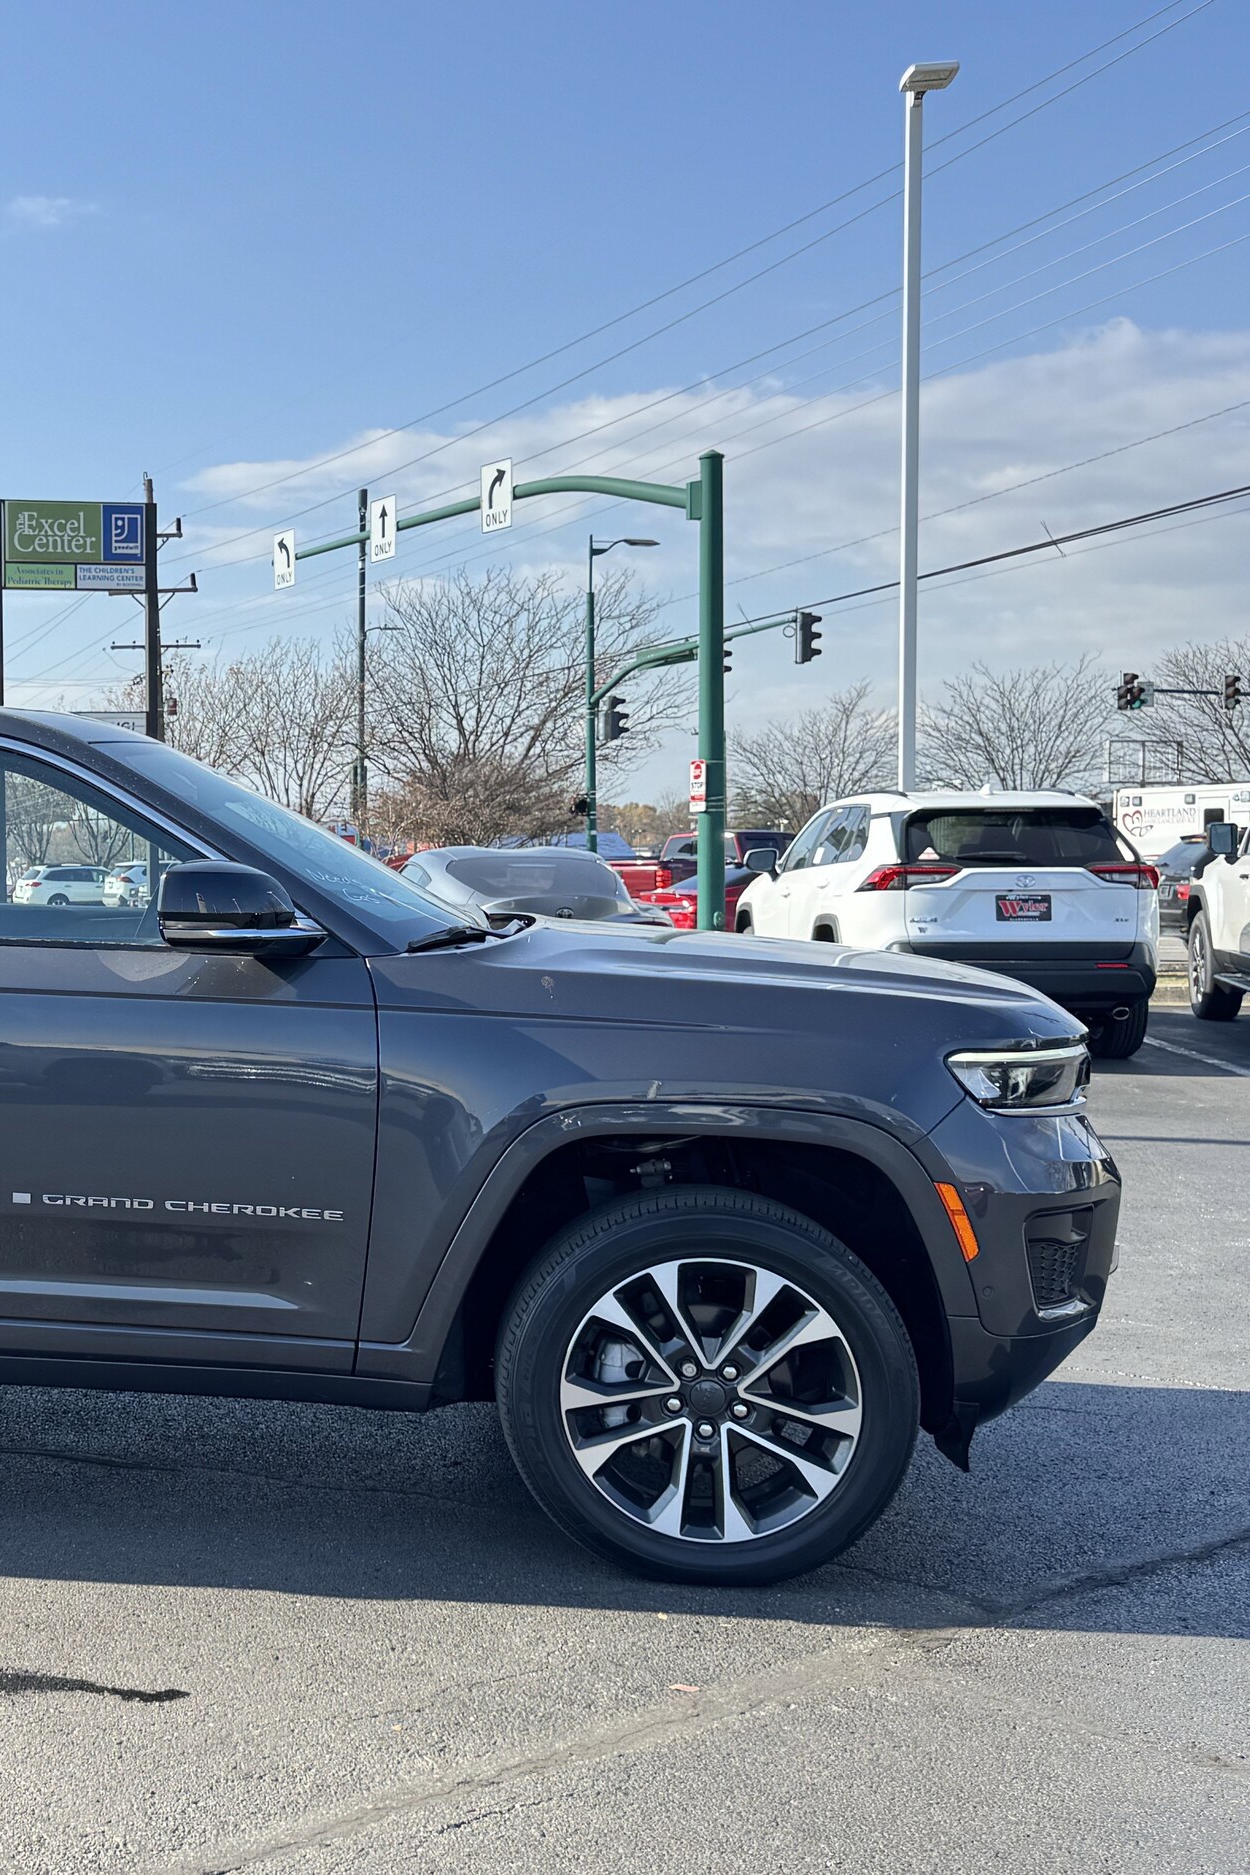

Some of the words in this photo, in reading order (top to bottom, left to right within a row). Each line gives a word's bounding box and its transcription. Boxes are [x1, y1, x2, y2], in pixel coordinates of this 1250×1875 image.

[22, 511, 86, 536] Excel
[485, 510, 508, 527] ONLY
[13, 528, 96, 553] Center
[374, 541, 392, 557] ONLY
[14, 566, 54, 575] Associates
[56, 567, 63, 575] in
[79, 574, 115, 582] LEARNING
[94, 567, 135, 575] CHILDREN'S
[44, 577, 72, 588] Therapy
[277, 571, 293, 586] ONLY
[1143, 807, 1197, 818] HEARTLAND
[42, 1194, 154, 1210] GRAND
[165, 1201, 344, 1221] CHEROKEE
